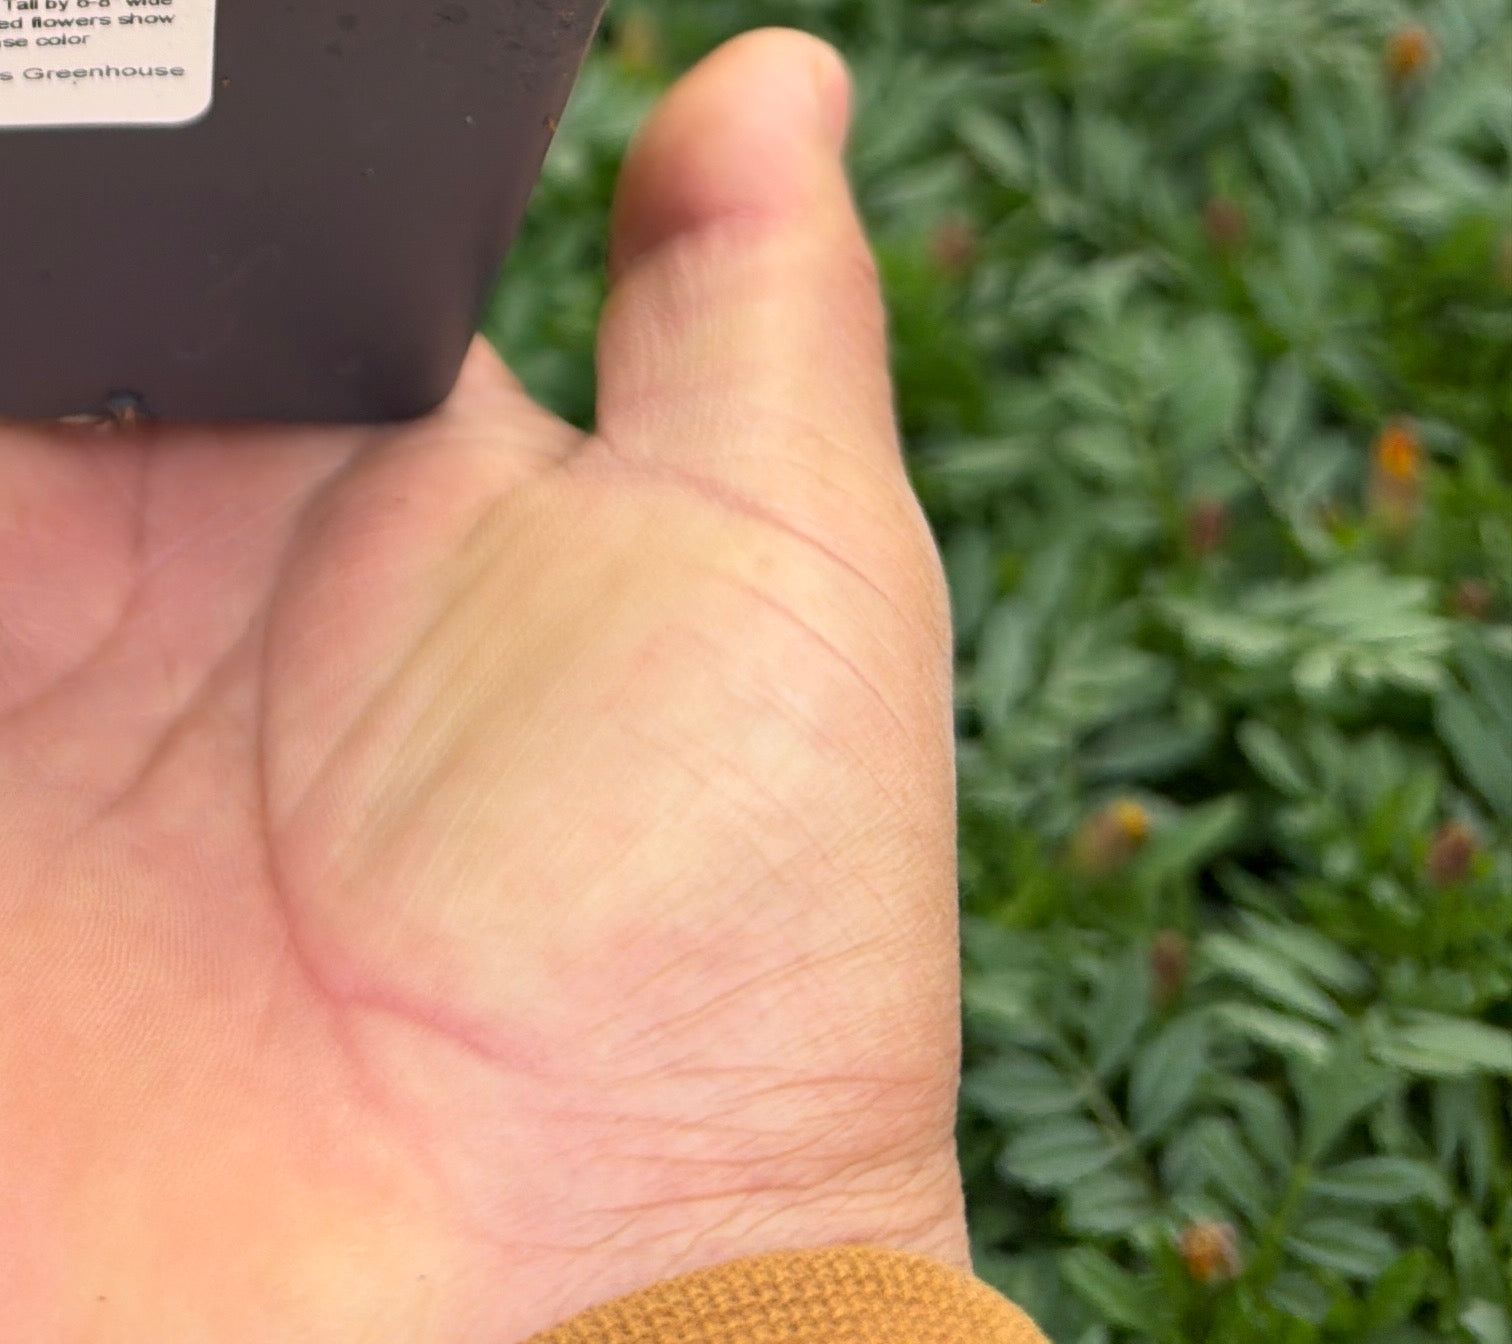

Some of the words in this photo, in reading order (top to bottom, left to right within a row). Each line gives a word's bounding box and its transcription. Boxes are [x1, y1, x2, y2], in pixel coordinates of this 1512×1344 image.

[31, 15, 112, 29] flowers
[118, 12, 176, 25] show
[35, 33, 91, 47] color
[22, 64, 186, 81] Greenhouse
